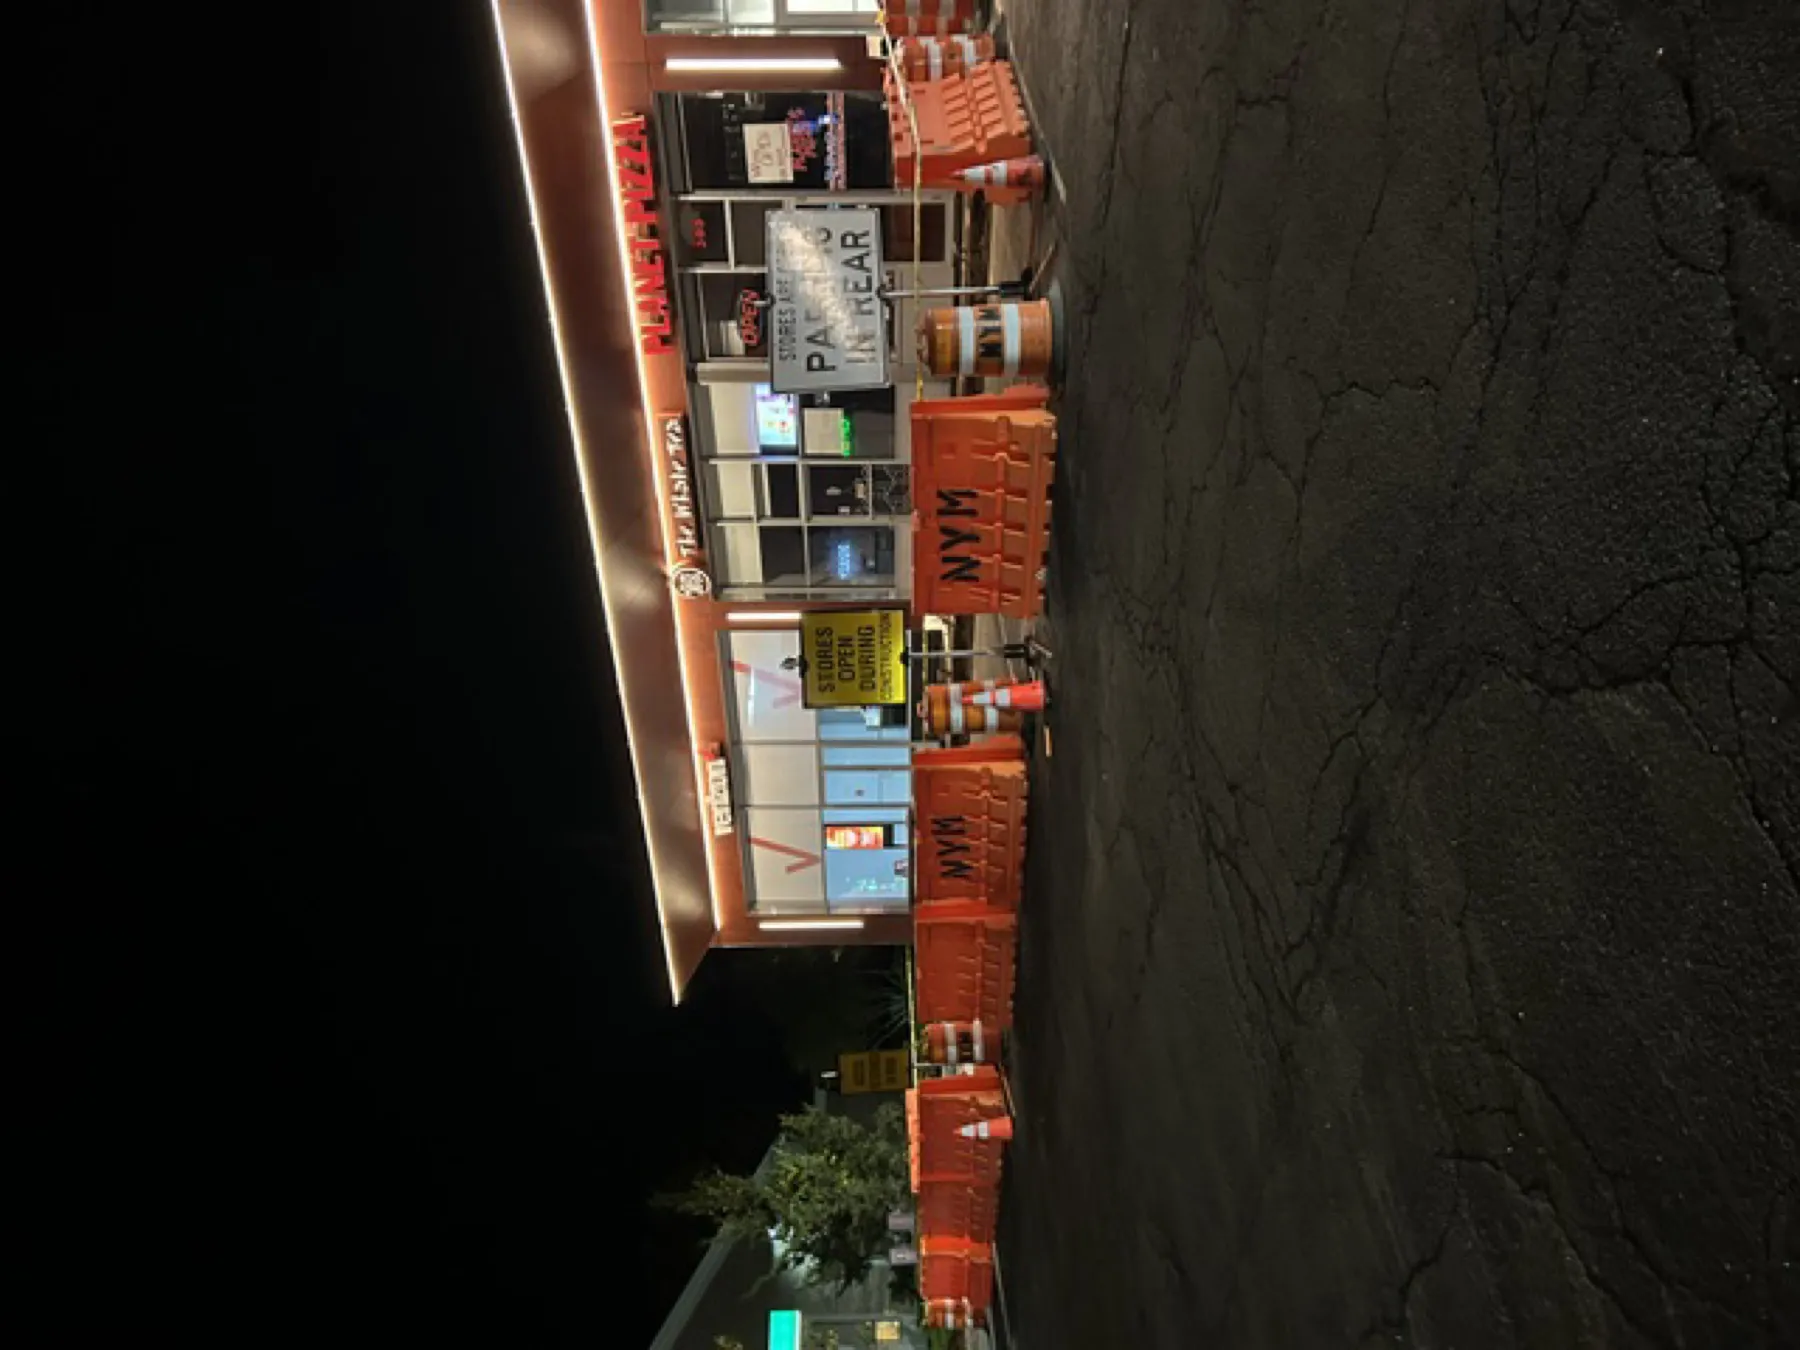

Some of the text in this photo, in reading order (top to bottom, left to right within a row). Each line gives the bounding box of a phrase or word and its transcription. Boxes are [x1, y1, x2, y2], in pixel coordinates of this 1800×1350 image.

[612, 118, 674, 355] PLANET PIZZA
[741, 288, 760, 346] OPEN
[840, 230, 876, 364] IN REAR
[778, 309, 796, 360] STORES
[675, 526, 695, 557] The
[936, 490, 980, 583] NYM
[815, 627, 835, 692] STORES
[837, 636, 855, 681] OPEN
[858, 625, 876, 691] DURING
[931, 816, 973, 878] NYM
